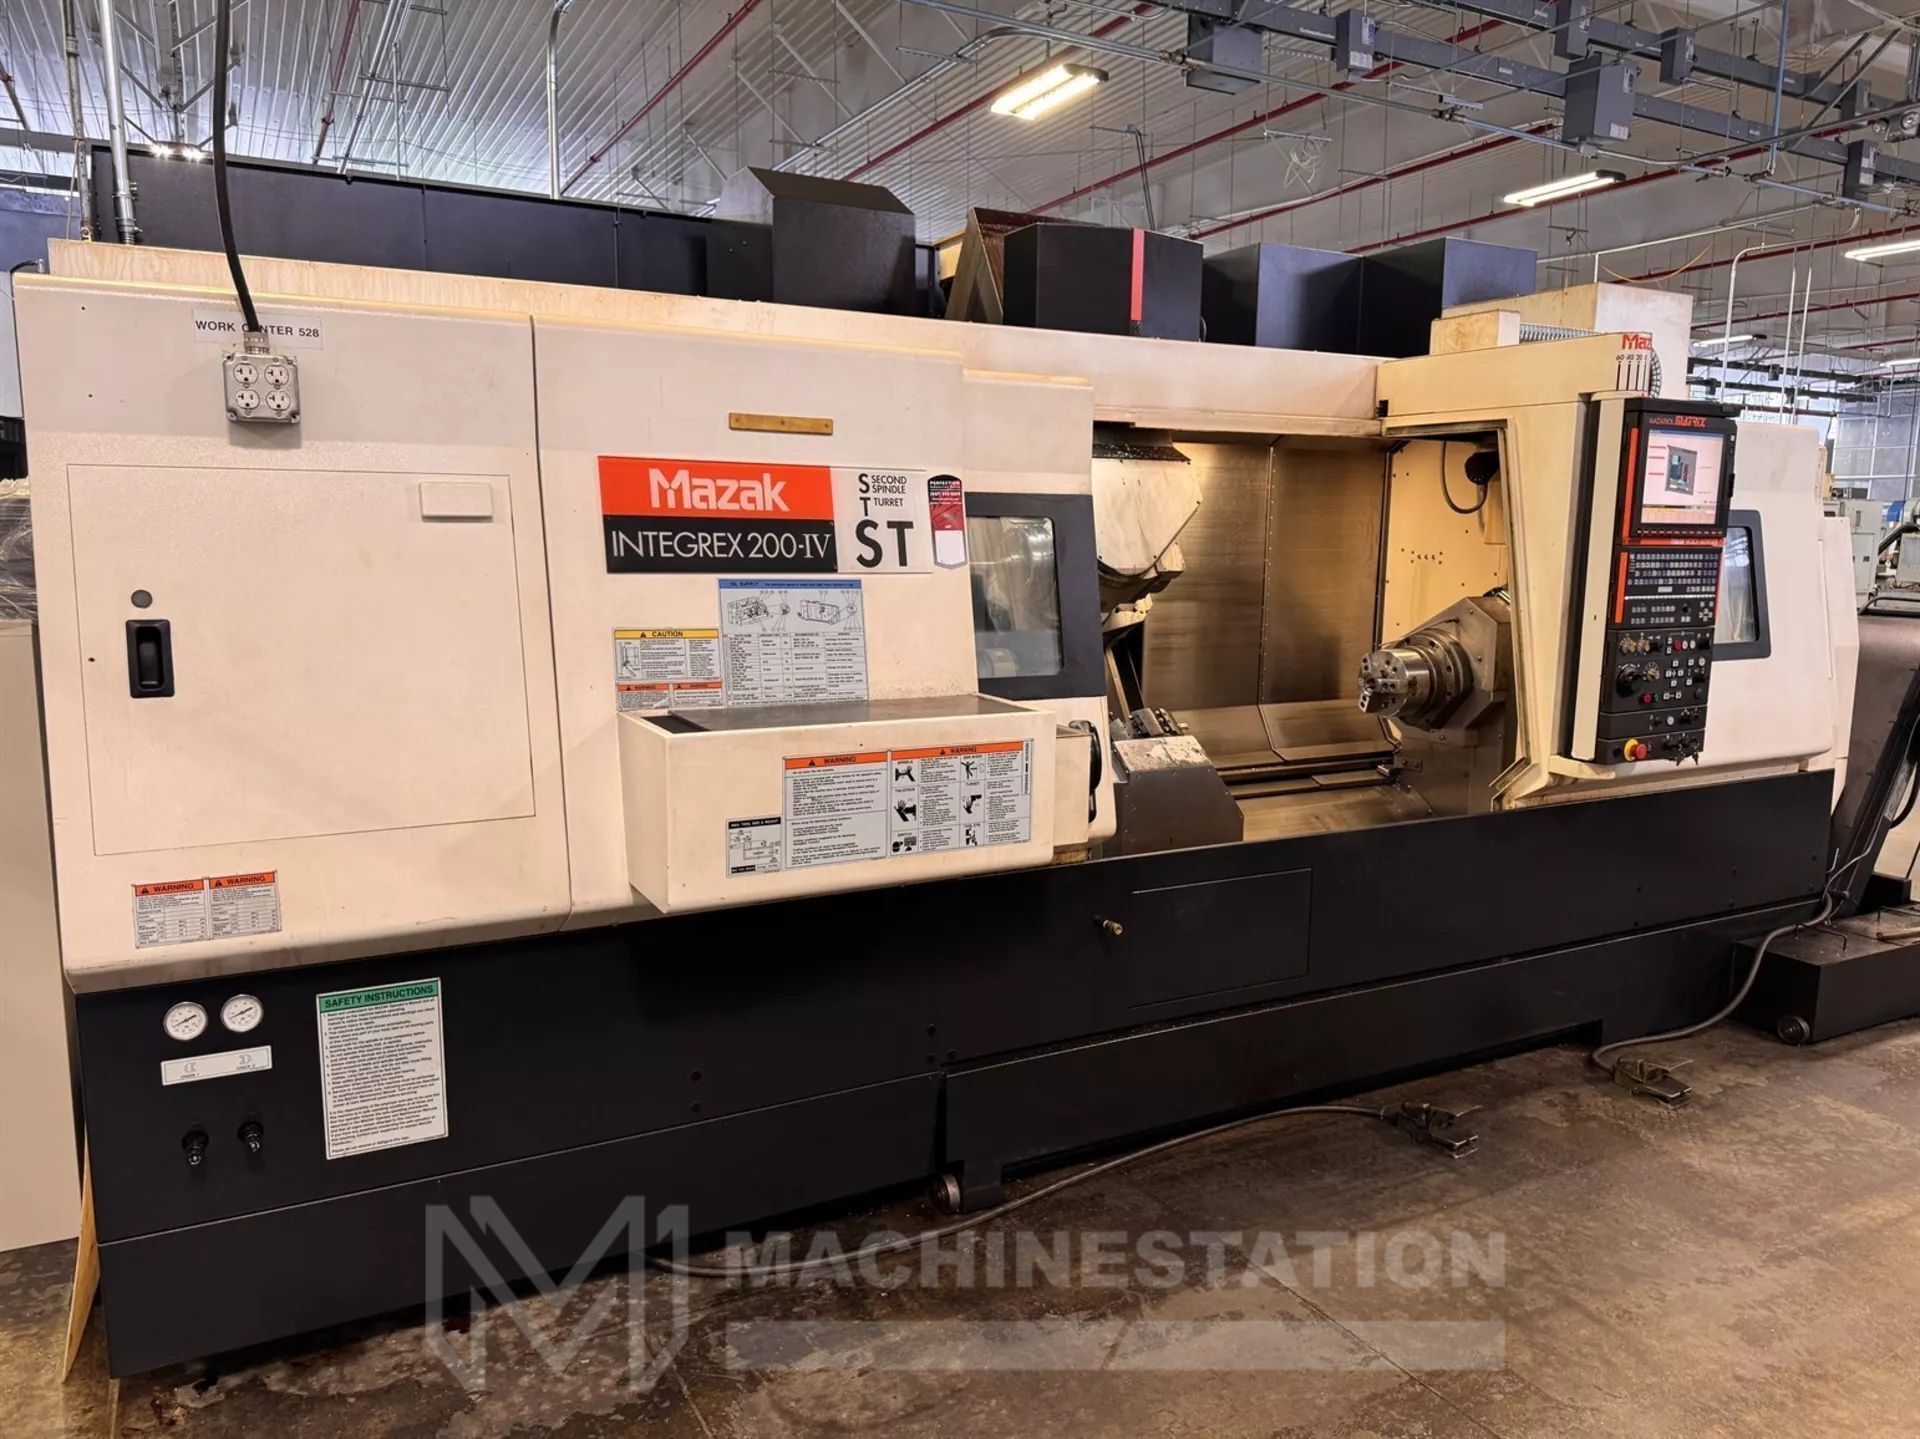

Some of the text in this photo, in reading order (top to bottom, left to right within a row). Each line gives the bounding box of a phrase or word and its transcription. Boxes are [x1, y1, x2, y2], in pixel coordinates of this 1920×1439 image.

[195, 320, 320, 338] WORK CNTER 528
[871, 475, 907, 485] SECOND
[648, 467, 790, 512] Mazak
[872, 485, 906, 494] SPINDLE
[874, 497, 904, 507] TURRET
[612, 530, 832, 558] INTEGREX 200-IV
[949, 746, 977, 755] WARNING
[824, 756, 856, 764] WARNING
[227, 874, 266, 885] WARNING
[153, 882, 194, 893] WARNING
[324, 985, 434, 1009] SAFETY INSTRUCTIONS
